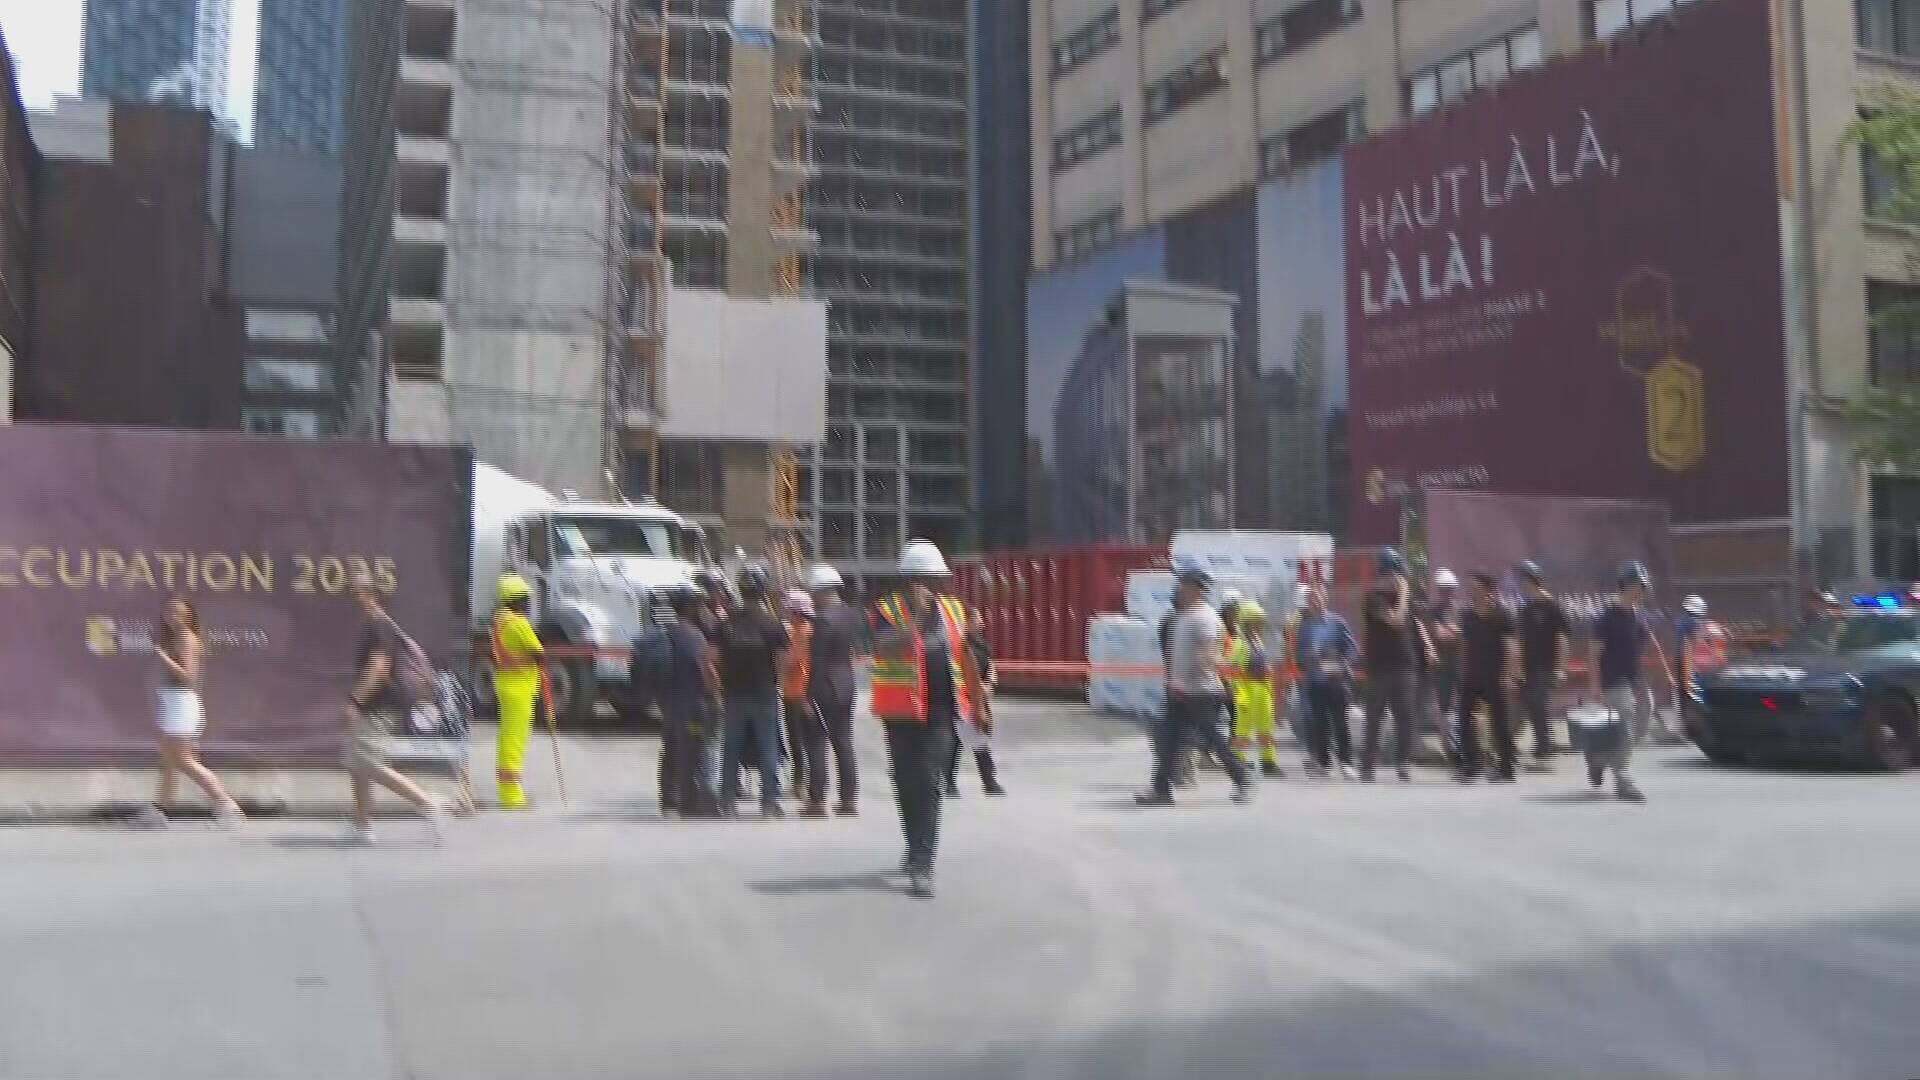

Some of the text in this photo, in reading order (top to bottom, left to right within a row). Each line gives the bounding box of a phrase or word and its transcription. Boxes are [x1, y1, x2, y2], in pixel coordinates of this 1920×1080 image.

[1359, 106, 1621, 246] HAUT LÀ LÀ,
[1361, 249, 1411, 318] LÀ
[1419, 231, 1473, 301] LÀ
[1664, 388, 1690, 444] 2
